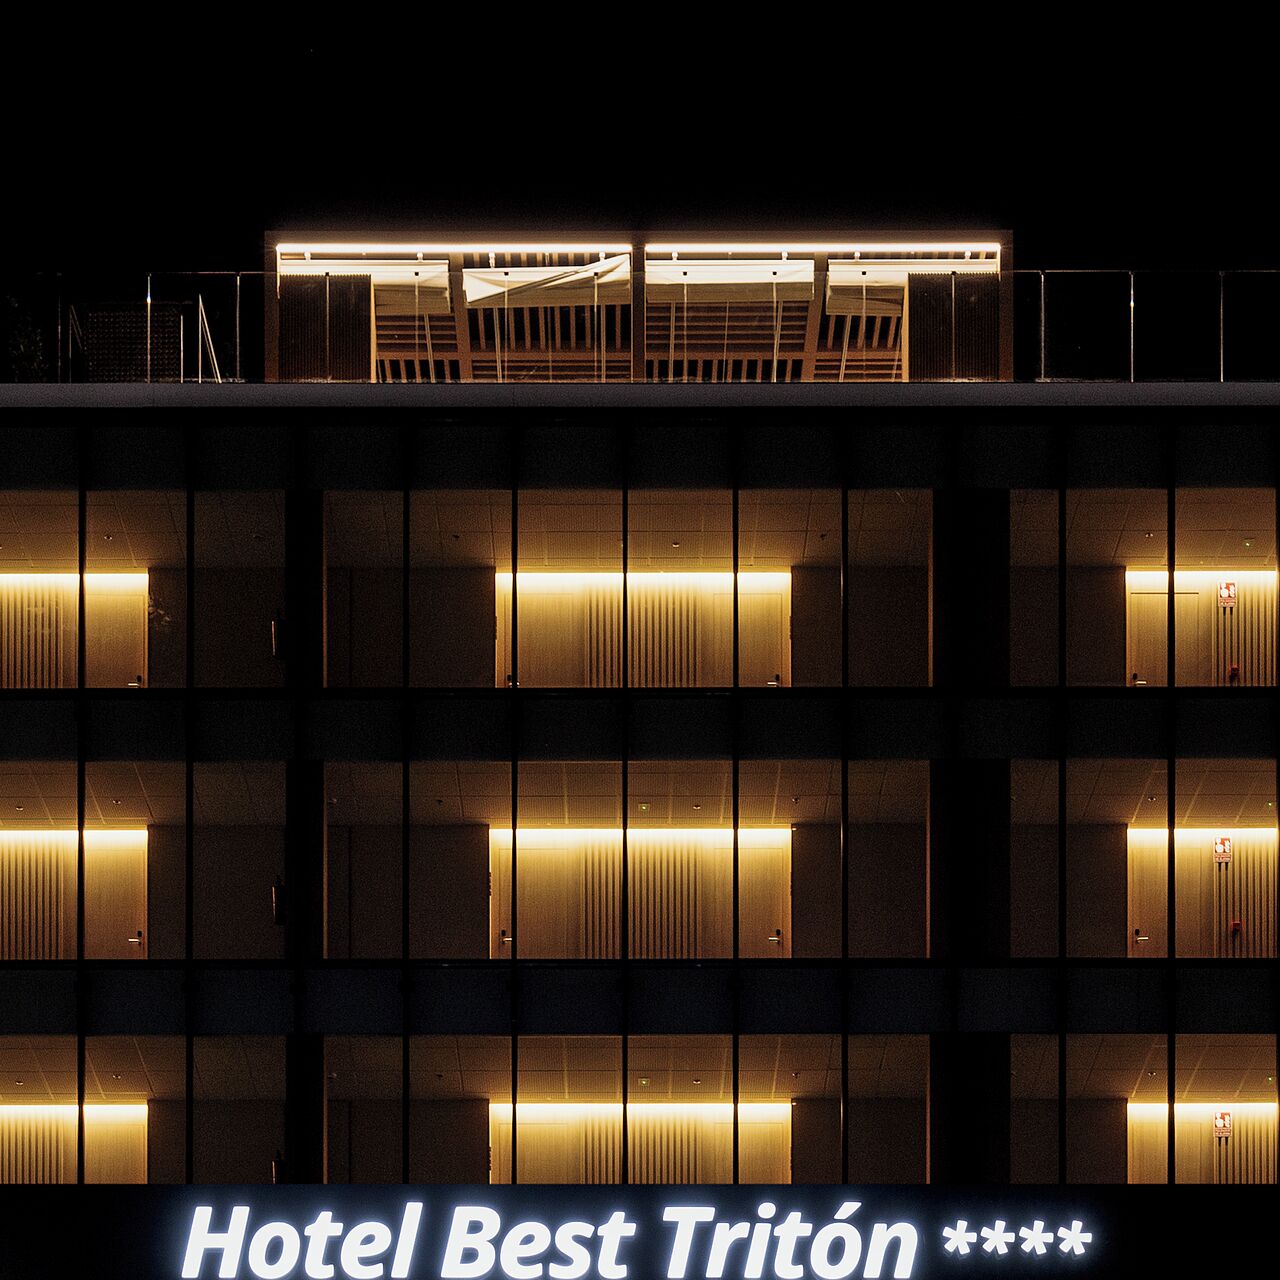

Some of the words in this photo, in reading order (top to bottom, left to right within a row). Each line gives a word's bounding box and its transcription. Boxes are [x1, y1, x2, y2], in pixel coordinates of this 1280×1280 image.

[181, 1201, 424, 1280] Hotel
[440, 1205, 637, 1280] Best
[662, 1201, 919, 1280] Tritón
